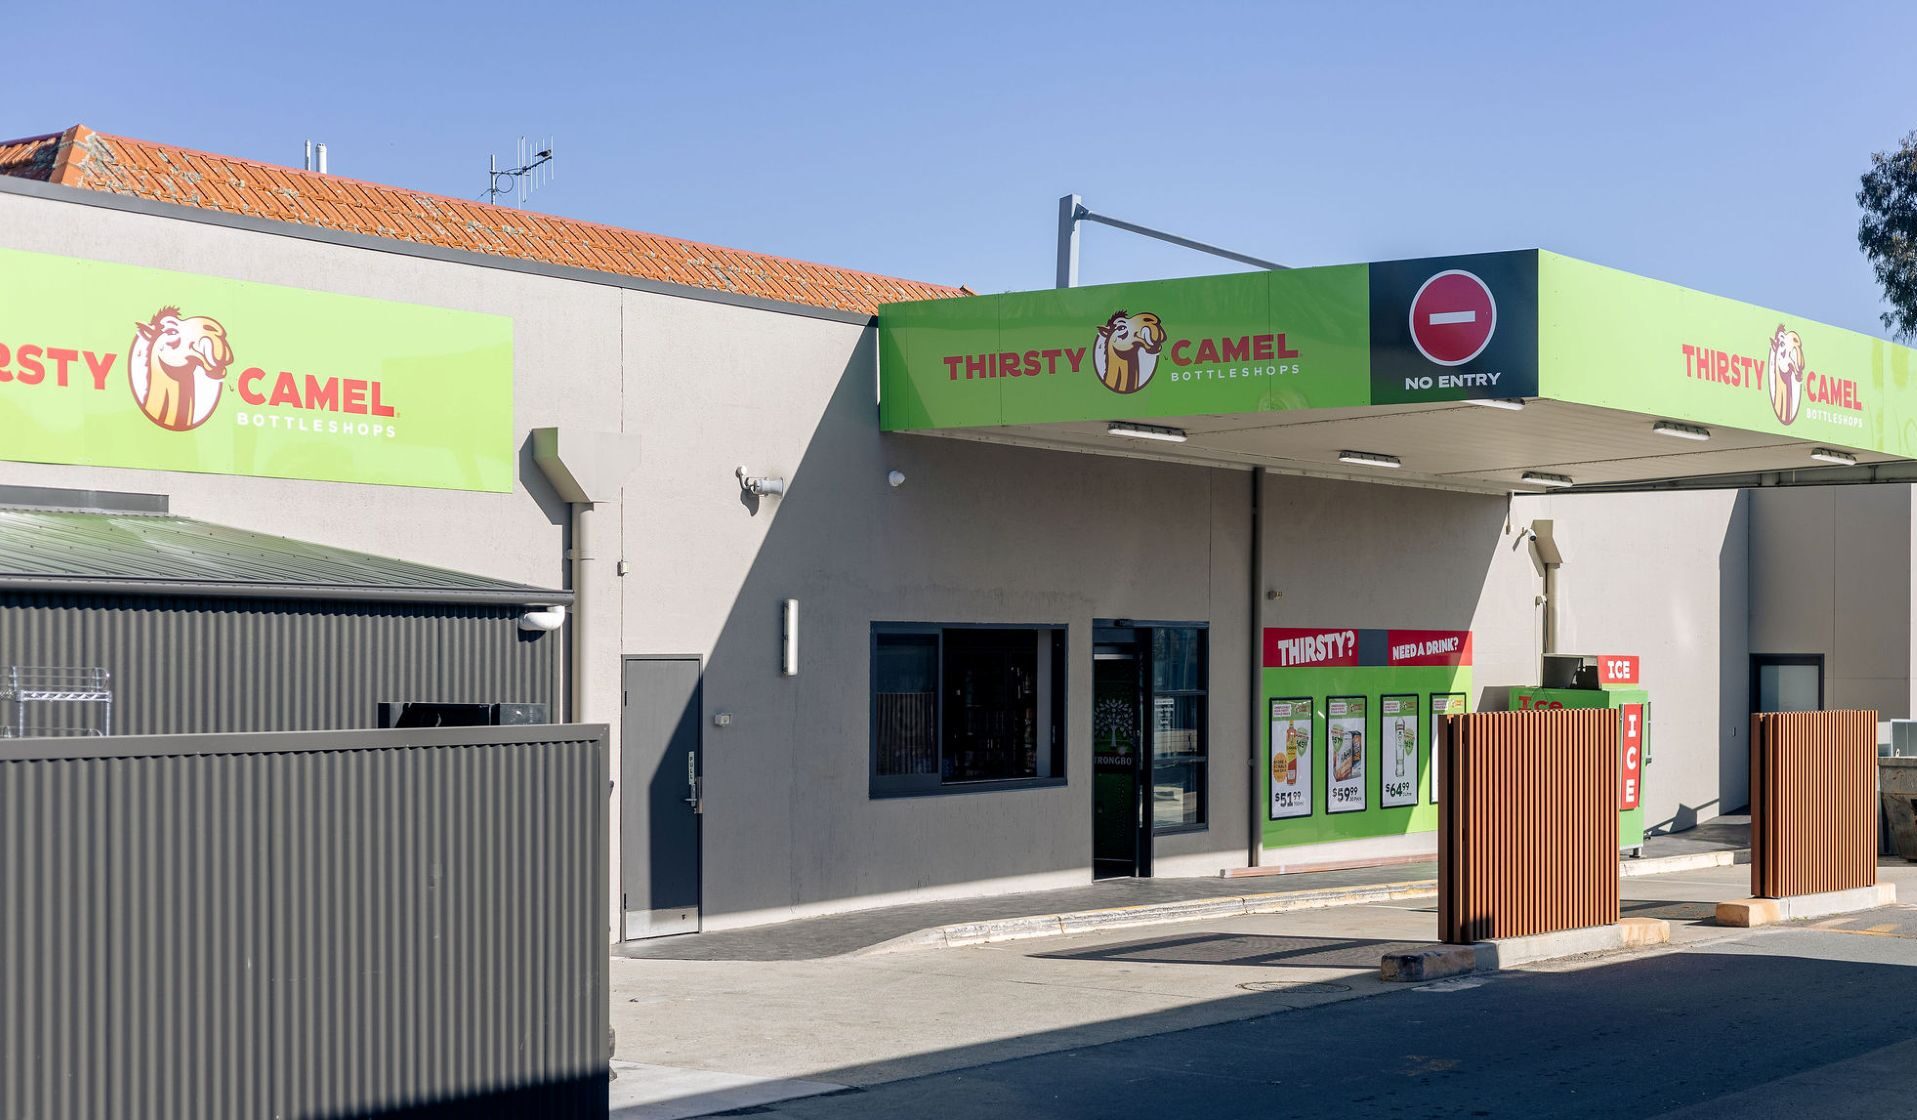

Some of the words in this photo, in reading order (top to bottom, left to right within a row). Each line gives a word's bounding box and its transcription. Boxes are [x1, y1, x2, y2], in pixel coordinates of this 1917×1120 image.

[944, 347, 1087, 380] THIRSTY
[1171, 333, 1299, 366] CAMEL
[1171, 364, 1300, 382] BOTTLESHOPS
[1405, 376, 1433, 391] NO
[1438, 372, 1501, 389] ENTRY
[1682, 344, 1765, 390] THIRSTY
[1806, 371, 1862, 411] CAMEL
[237, 367, 395, 418] CAMEL
[236, 412, 396, 438] BOTTLESHOPS
[1806, 407, 1863, 428] BOTTLESHOPS
[1278, 630, 1355, 667] THIRSTY?
[1392, 641, 1416, 661] NEED
[1417, 643, 1425, 657] A
[1426, 636, 1459, 655] DRINK?
[1607, 660, 1631, 679] ICE
[1625, 714, 1637, 803] ICE
